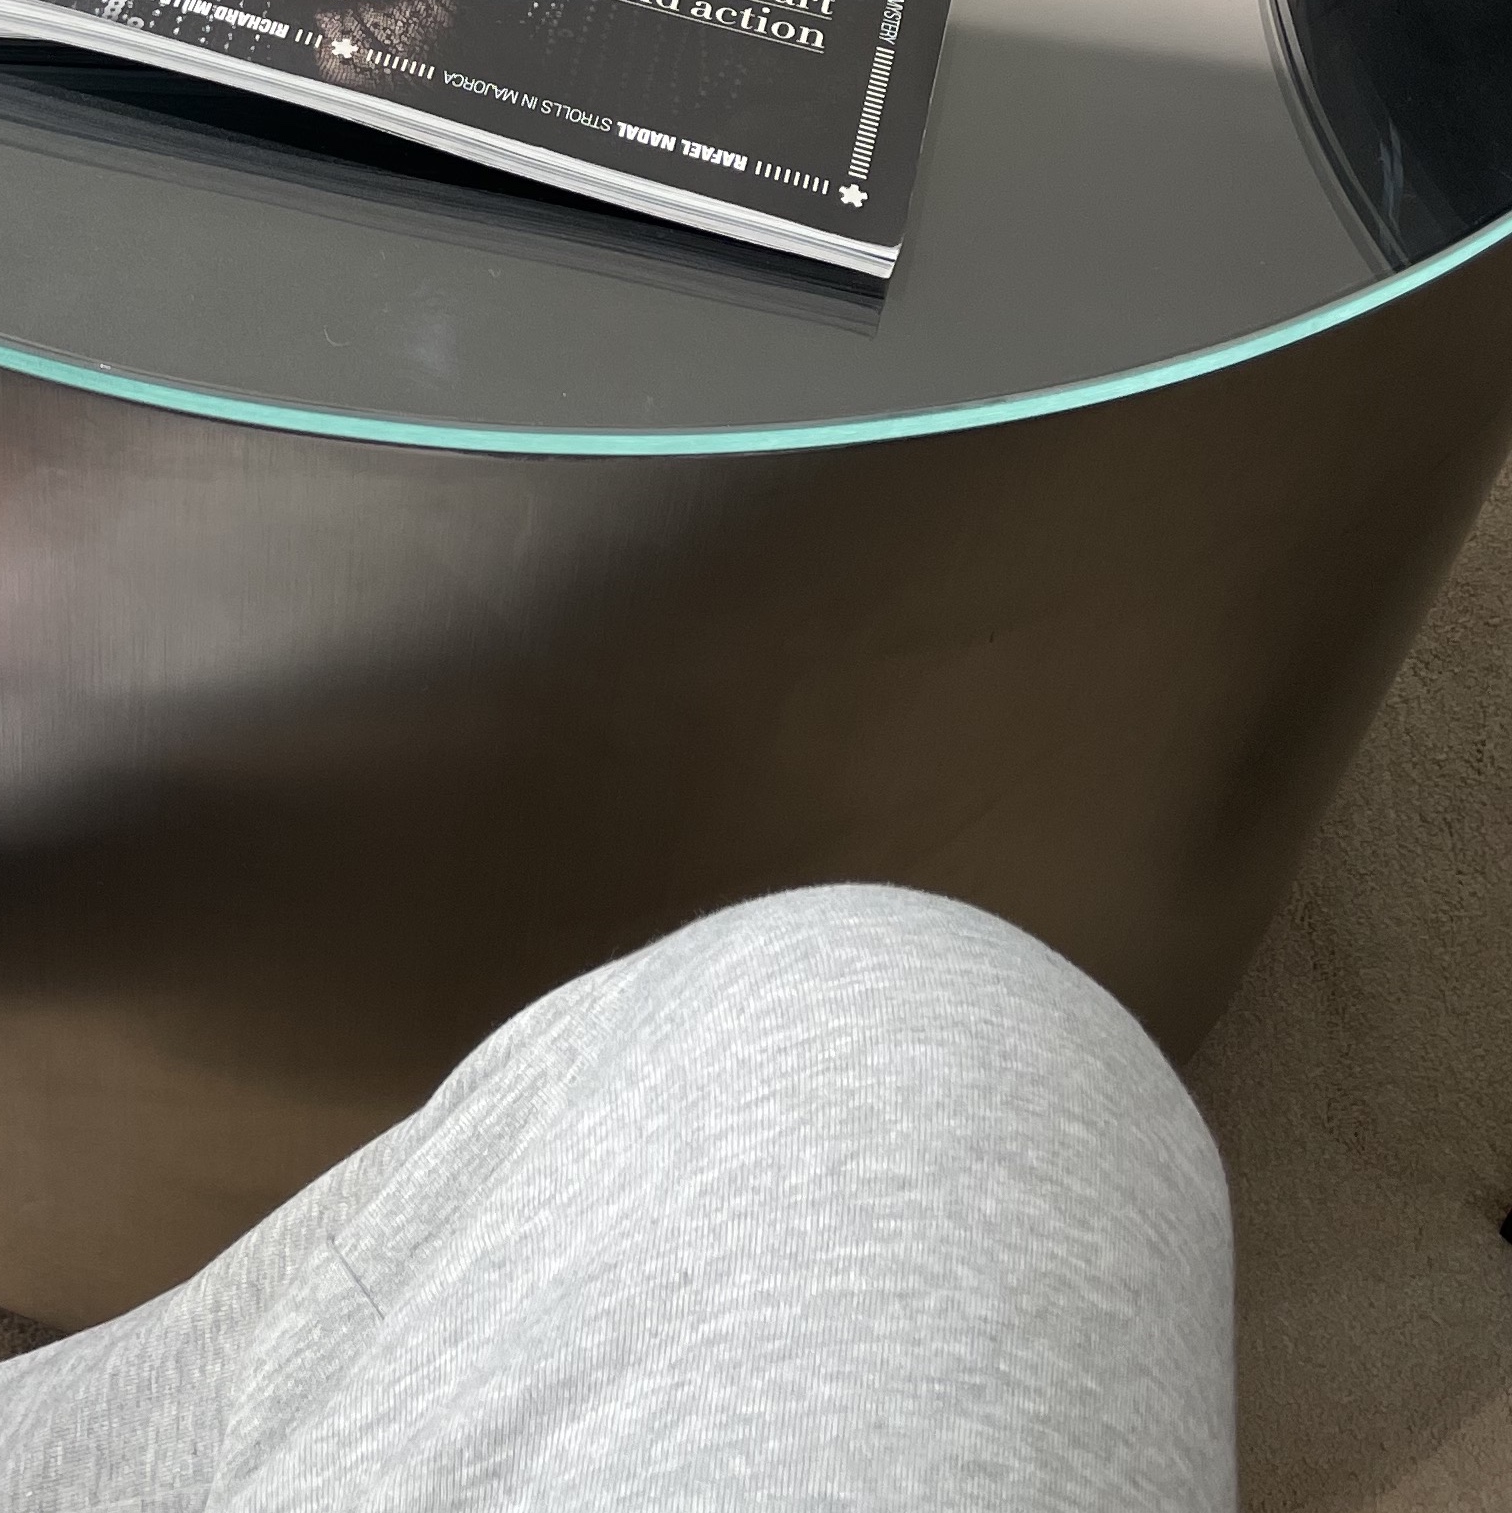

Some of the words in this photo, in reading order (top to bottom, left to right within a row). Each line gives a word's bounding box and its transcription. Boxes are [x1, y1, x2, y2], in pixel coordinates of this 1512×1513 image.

[212, 4, 289, 39] RICHARD
[690, 0, 826, 49] action
[440, 69, 519, 104] MAJORCA
[520, 92, 538, 109] IN
[539, 98, 613, 132] STROLLS
[613, 120, 676, 151] NADAL
[678, 138, 748, 171] RAFAEL
